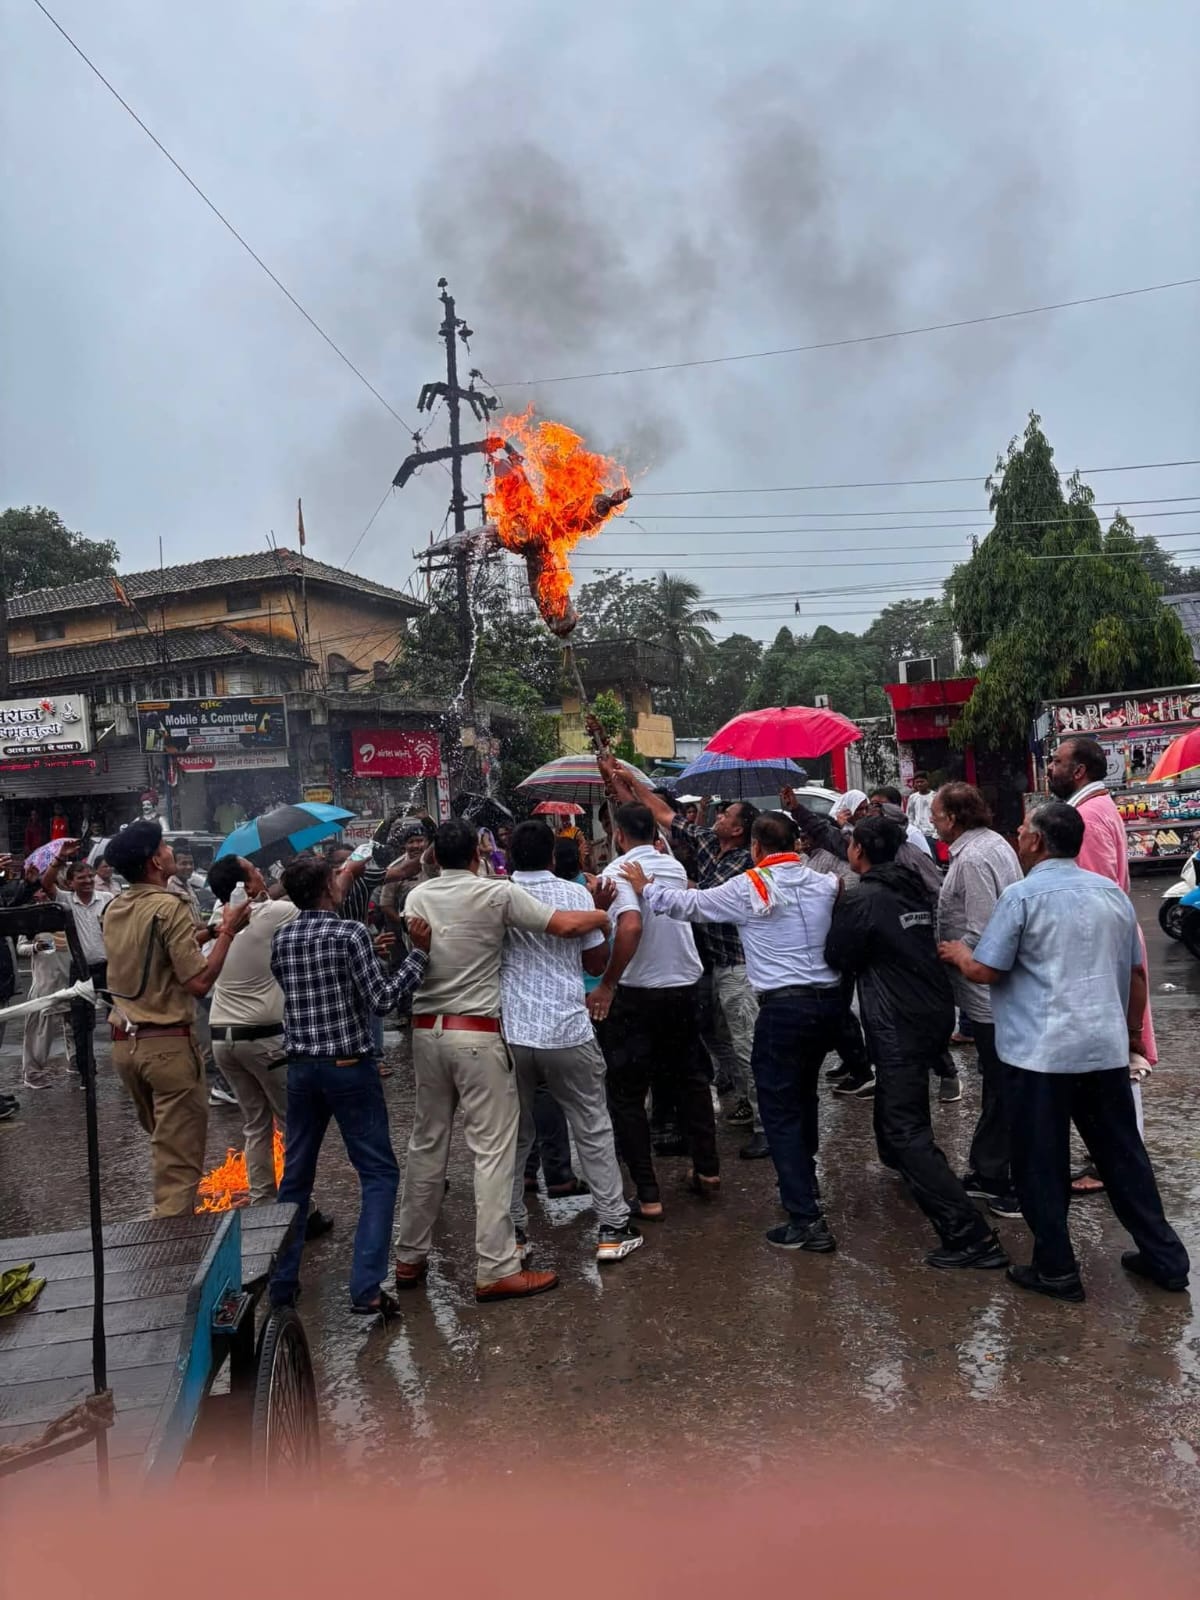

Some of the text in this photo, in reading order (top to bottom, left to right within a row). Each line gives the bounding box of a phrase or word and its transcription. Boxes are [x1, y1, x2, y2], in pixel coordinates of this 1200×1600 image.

[165, 712, 258, 726] Mobile & Computer
